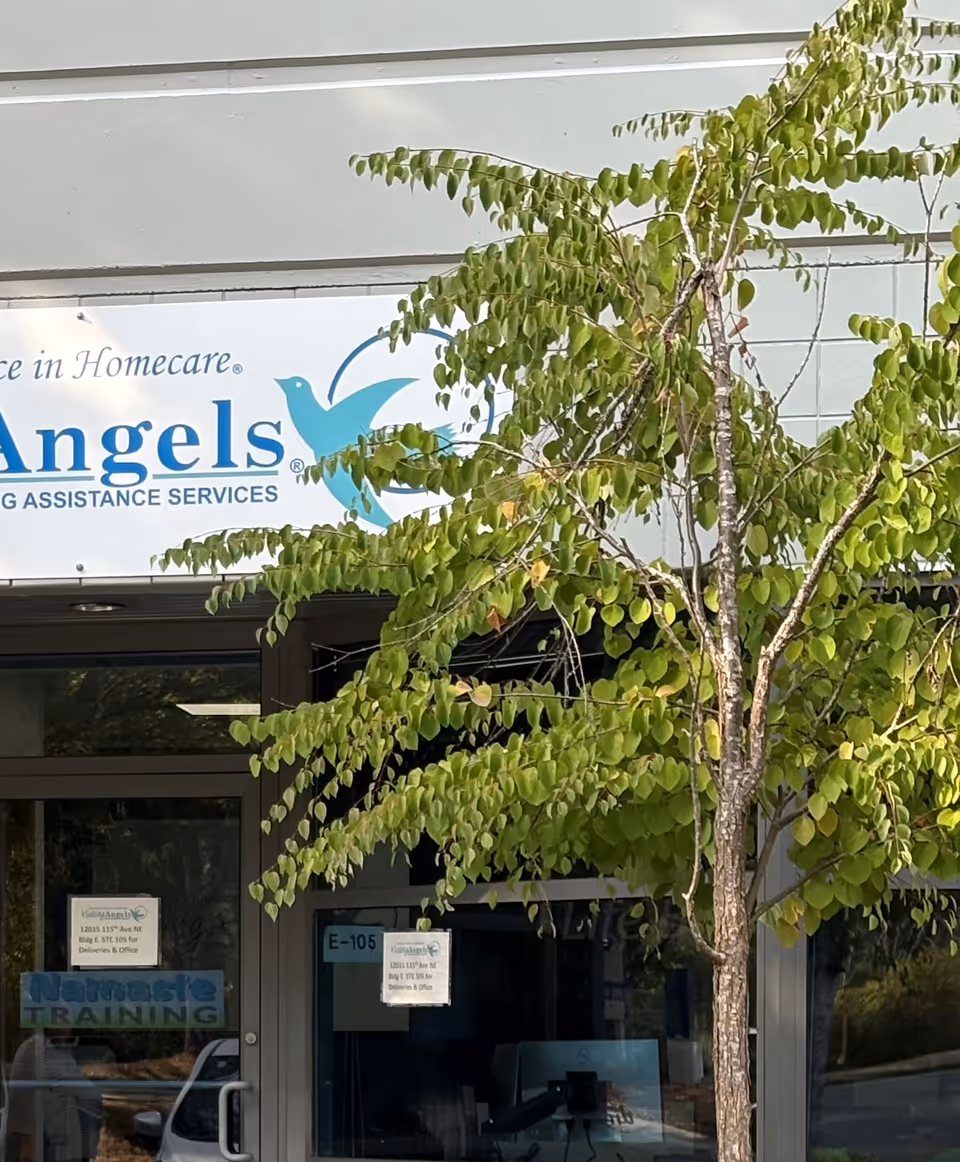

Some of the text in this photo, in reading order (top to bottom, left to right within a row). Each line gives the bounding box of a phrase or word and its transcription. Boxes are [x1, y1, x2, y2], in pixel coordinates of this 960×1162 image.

[33, 350, 63, 380] in
[23, 488, 161, 510] ASSISTANCE
[167, 484, 279, 506] SERVICES
[119, 925, 132, 933] Ave
[78, 946, 111, 954] Deliveries
[118, 946, 139, 954] Office
[329, 933, 376, 950] E-105
[23, 1005, 218, 1025] TRAINING
